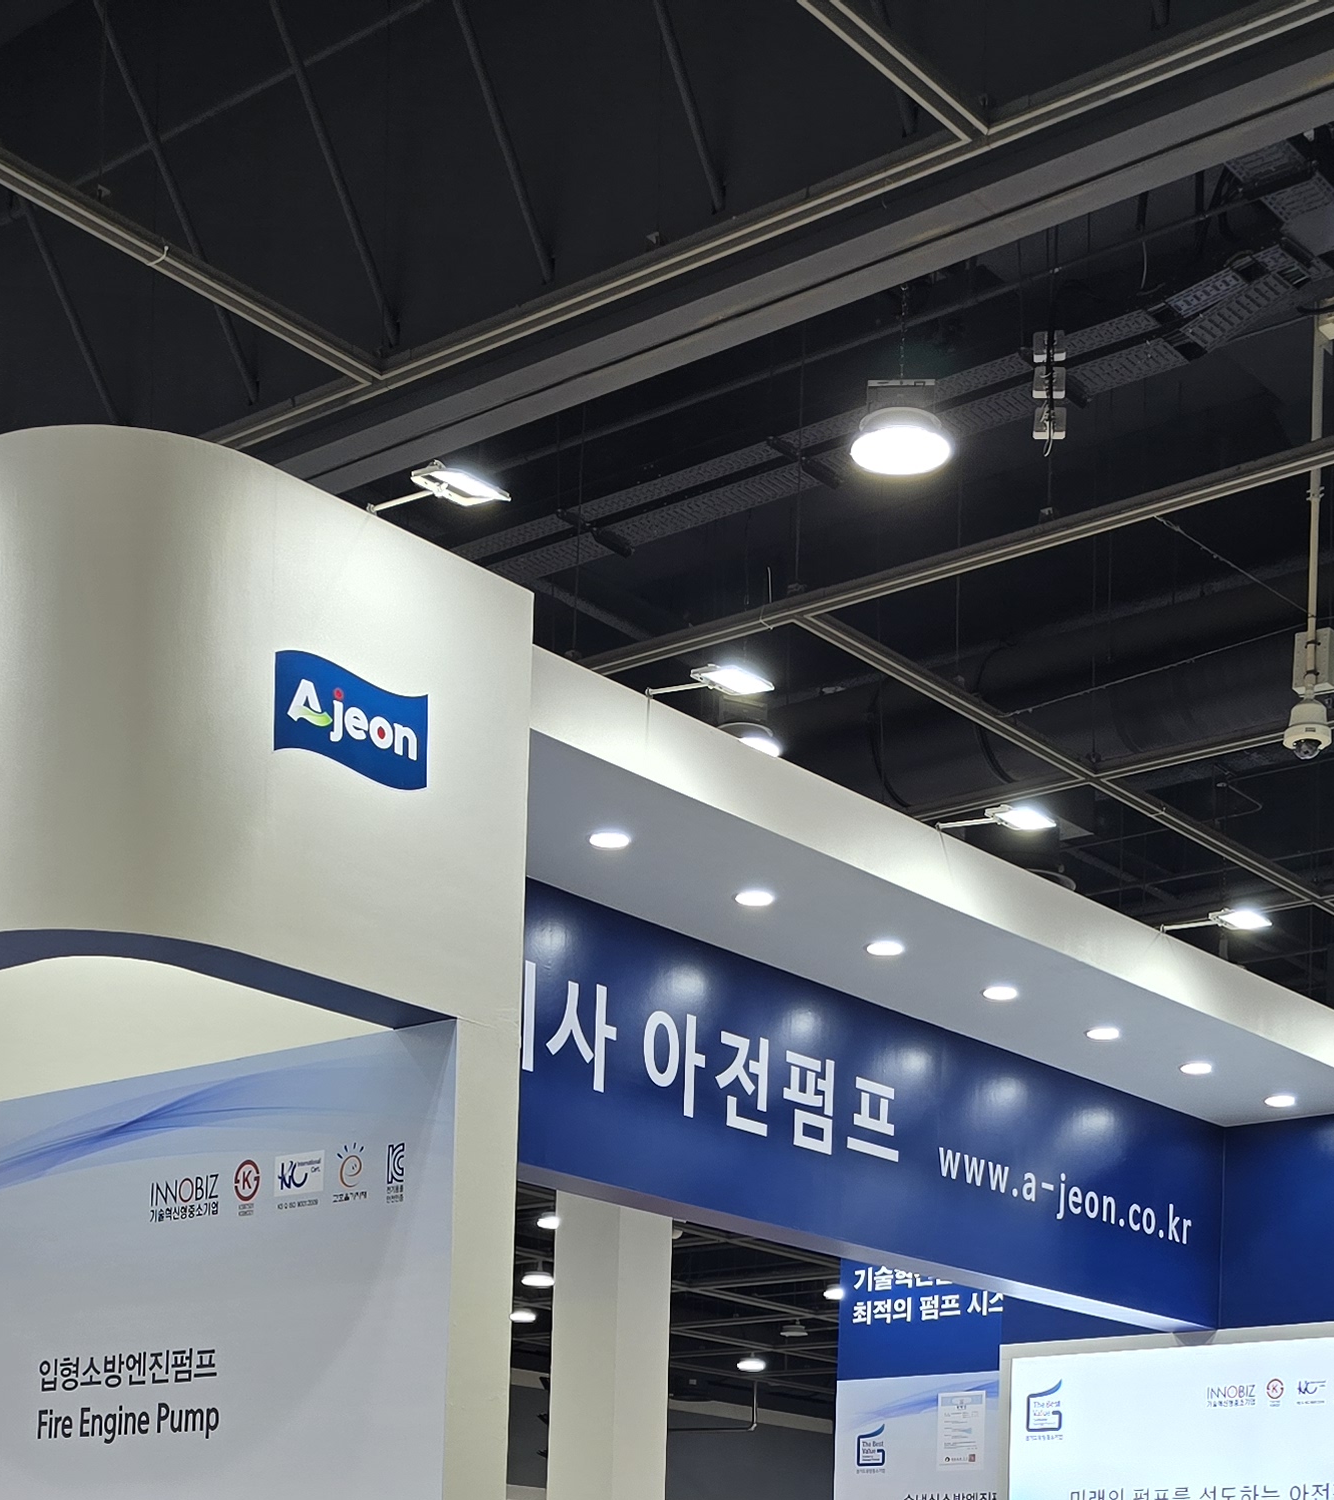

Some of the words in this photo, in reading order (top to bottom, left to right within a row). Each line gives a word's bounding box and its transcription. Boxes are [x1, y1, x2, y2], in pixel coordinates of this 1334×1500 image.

[286, 678, 420, 762] Ajeon
[643, 1010, 899, 1162] 아전펌프
[150, 1174, 219, 1207] INNOBIZ
[939, 1146, 1192, 1246] www.a-jeon.co.kr
[852, 1297, 911, 1324] 최적의
[920, 1295, 961, 1321] 펌프
[38, 1347, 217, 1392] 입형소방엔진펌프
[37, 1407, 73, 1440] Fire
[79, 1406, 149, 1444] Engine
[157, 1401, 220, 1438] Pump
